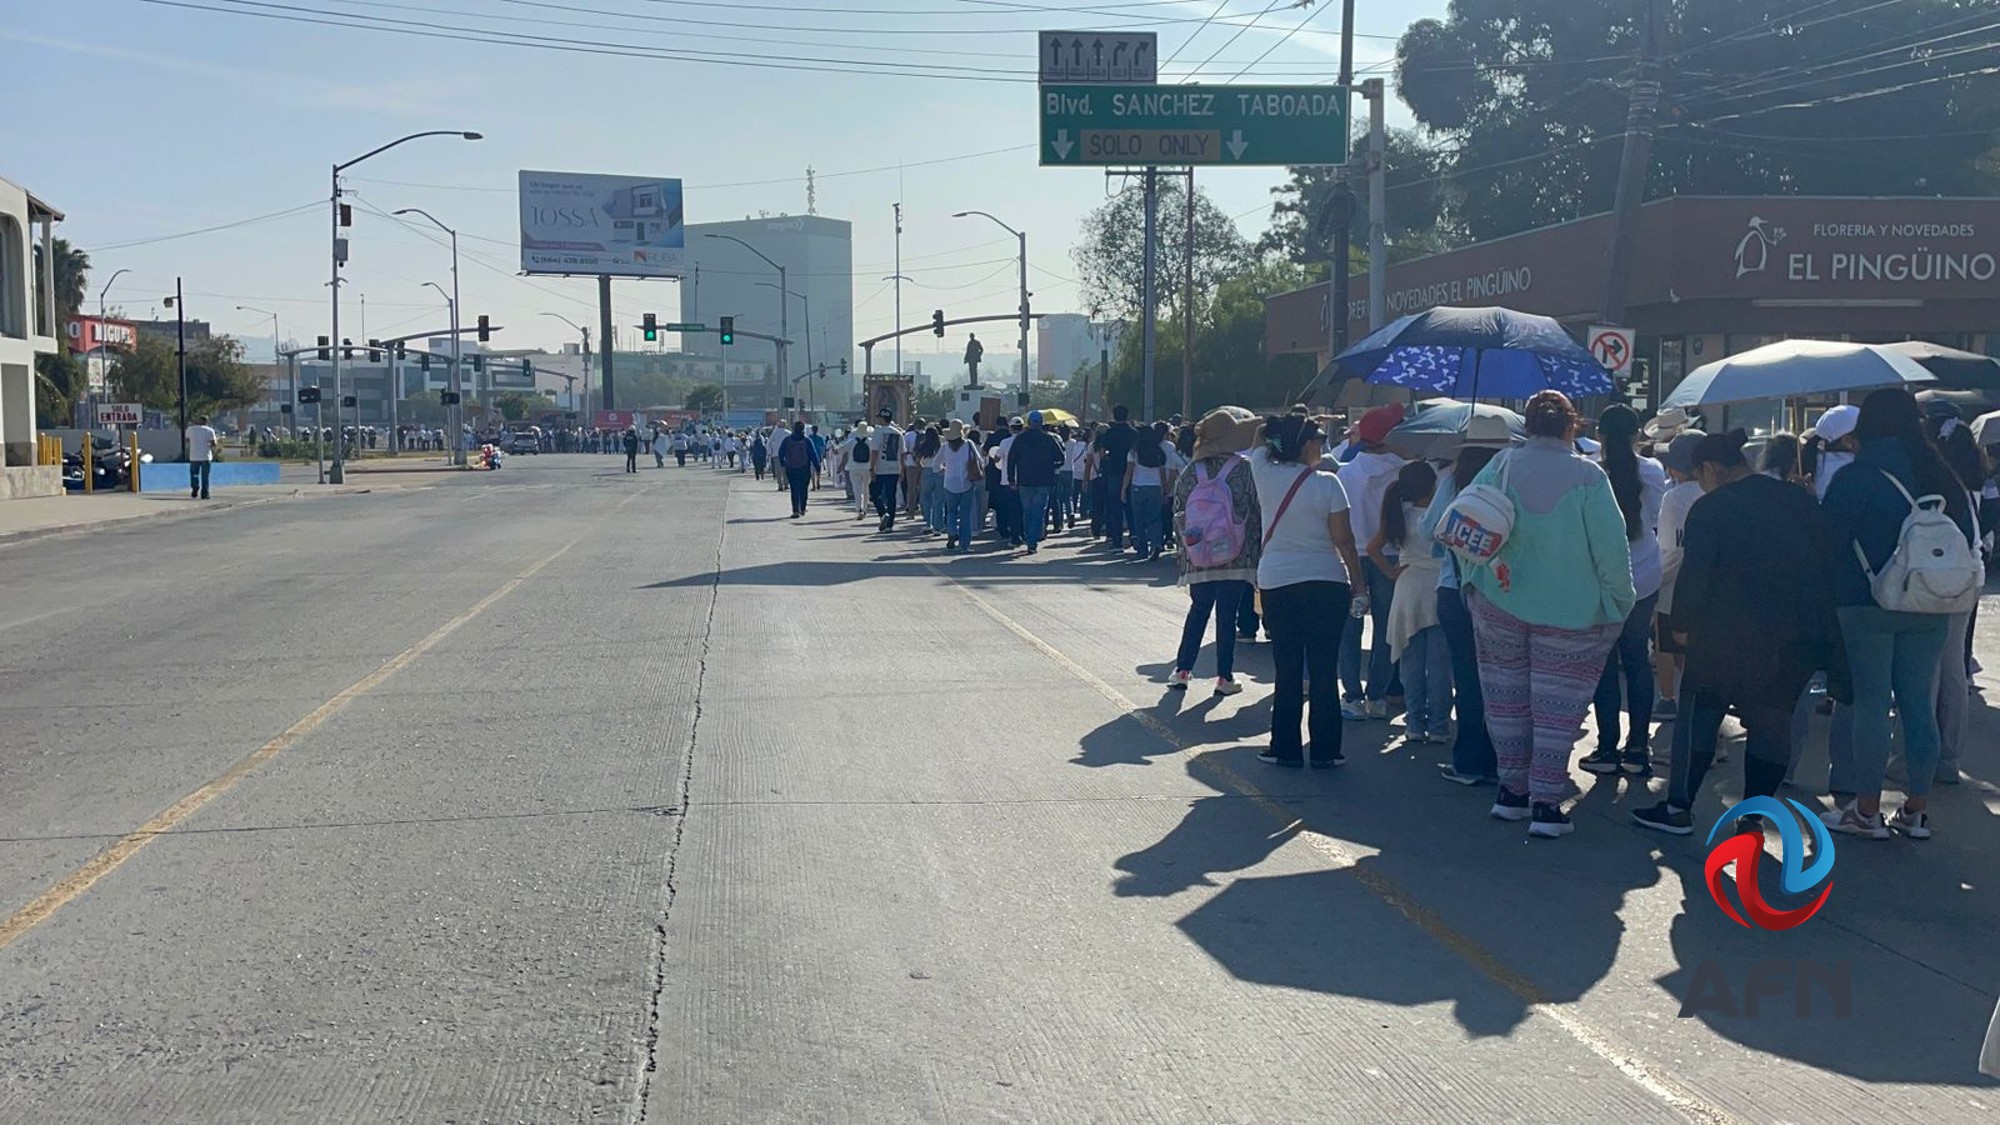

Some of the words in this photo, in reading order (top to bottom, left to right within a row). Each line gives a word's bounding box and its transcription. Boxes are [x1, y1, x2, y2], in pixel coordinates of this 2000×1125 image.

[1046, 92, 1094, 116] Blvd.
[1112, 94, 1215, 117] SANCHEZ
[1237, 94, 1341, 117] TABOADA
[1089, 134, 1142, 157] SOLO
[1159, 133, 1210, 156] ONLY
[1813, 223, 1876, 237] FLORERIA
[1879, 223, 1889, 237] Y
[1891, 223, 1974, 237] NOVEDADES
[1788, 253, 1820, 280] EL
[1831, 246, 1996, 280] PINGÜINO
[1386, 281, 1448, 313] NOVEDADES
[1450, 281, 1463, 302] EL
[1466, 266, 1532, 299] PINGÜINO
[100, 412, 137, 422] ENTRADA
[1448, 518, 1494, 552] ICEE
